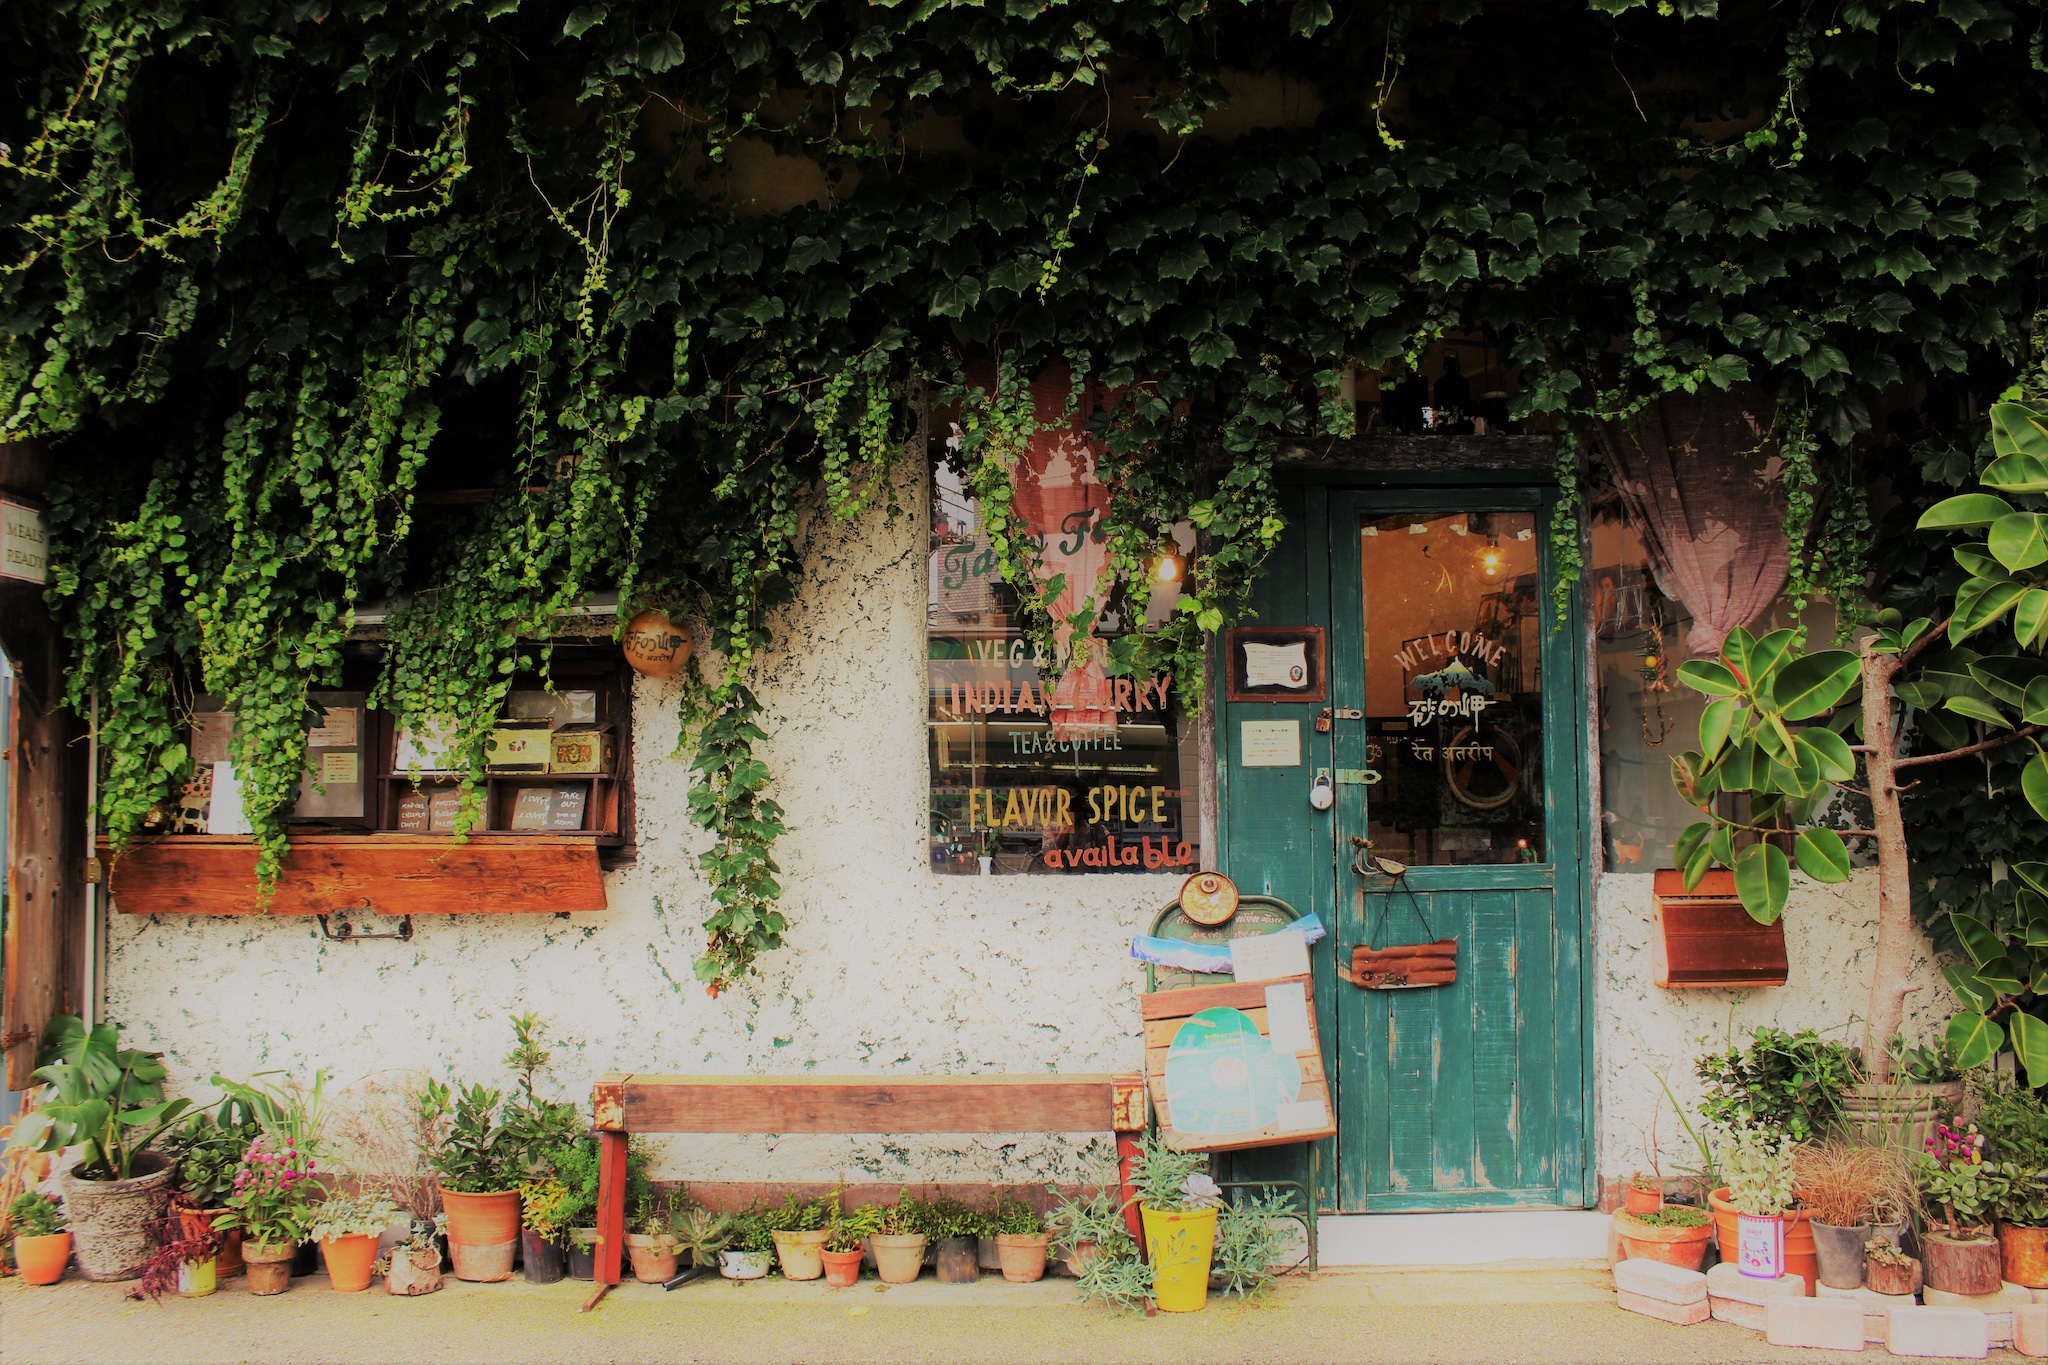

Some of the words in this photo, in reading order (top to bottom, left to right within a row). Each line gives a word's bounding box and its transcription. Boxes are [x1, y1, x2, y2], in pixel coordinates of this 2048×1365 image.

[7, 521, 45, 544] MEALS
[7, 549, 45, 568] READY
[976, 638, 1025, 669] VEG
[1032, 641, 1049, 669] &
[1393, 629, 1507, 672] WELCOME
[951, 679, 1057, 715] INDIAN
[1073, 676, 1171, 712] CURRY
[1411, 741, 1434, 762] रेत
[969, 787, 1073, 829] FLAVOR
[1088, 784, 1168, 824] SPICE
[1043, 835, 1194, 869] available
[1361, 970, 1408, 988] OPEN
